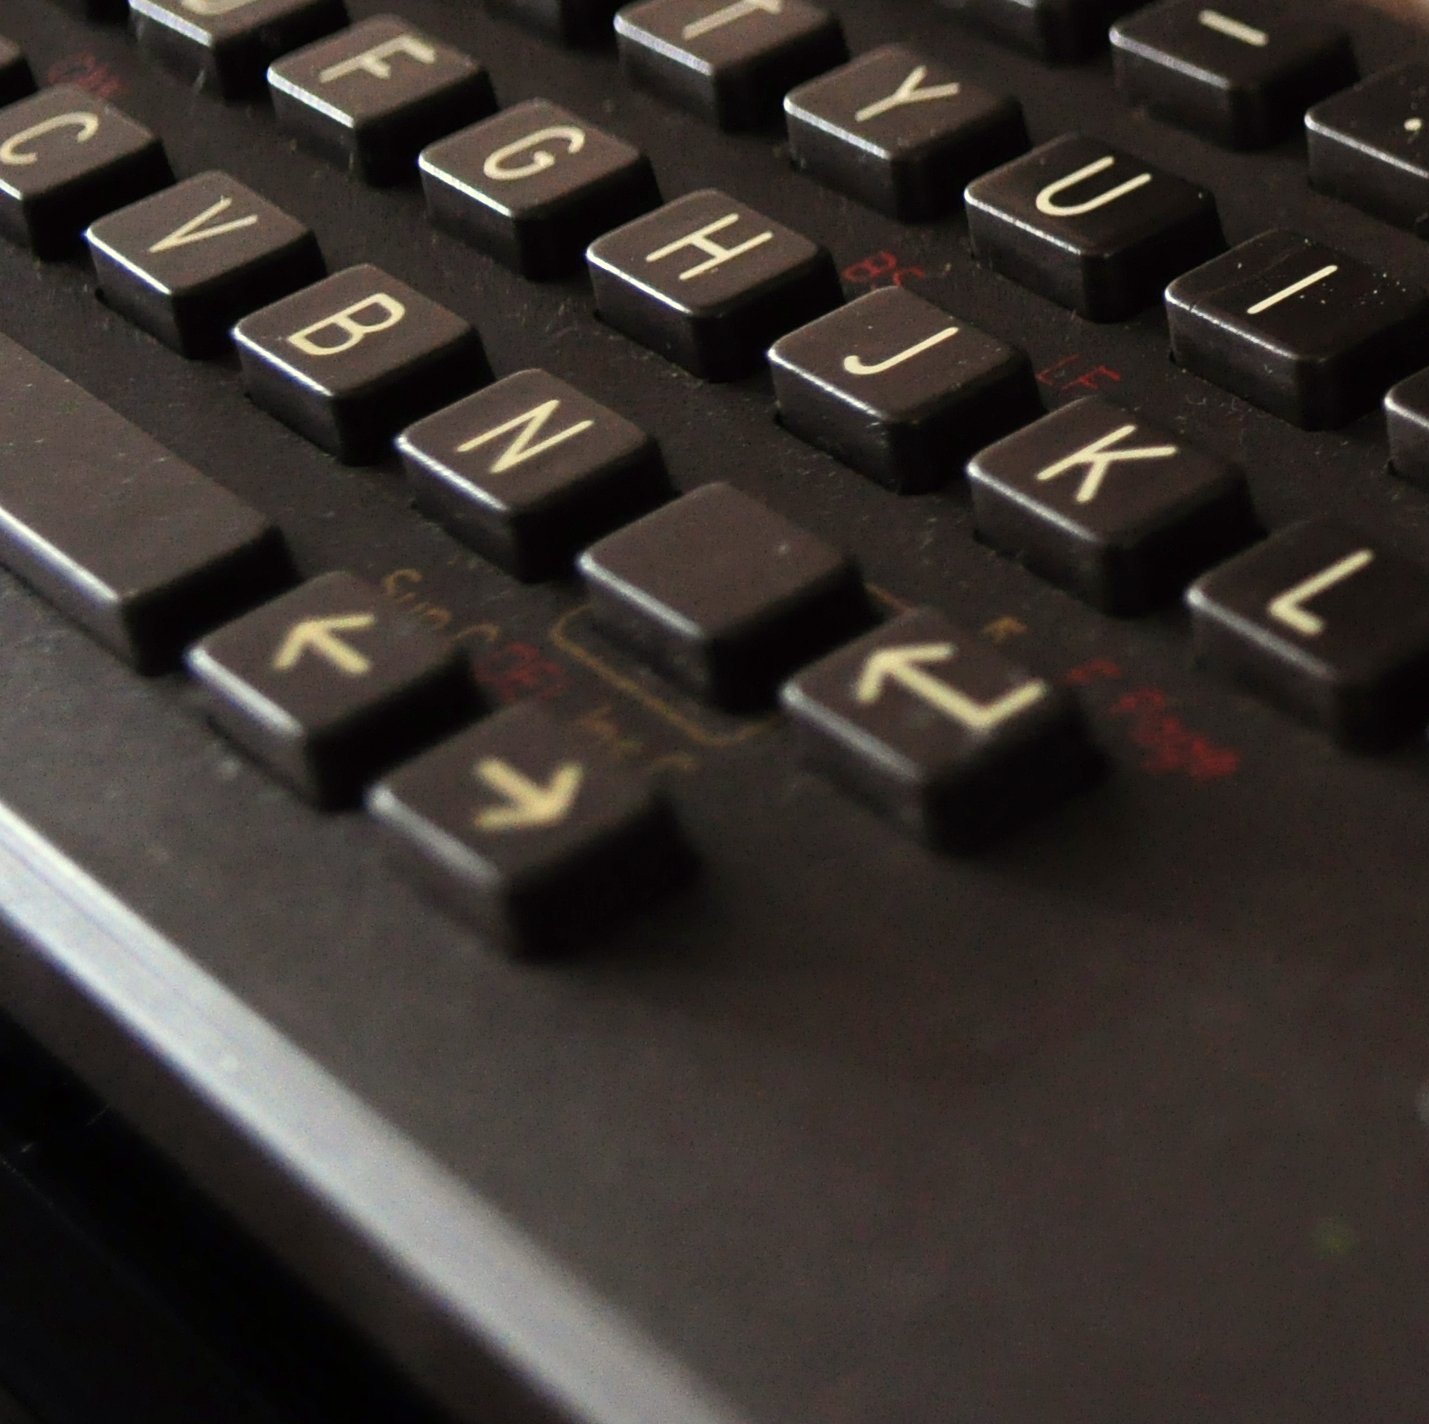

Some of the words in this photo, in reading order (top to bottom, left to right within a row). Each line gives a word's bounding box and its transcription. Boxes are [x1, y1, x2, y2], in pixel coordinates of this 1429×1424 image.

[319, 34, 437, 85] F
[855, 65, 960, 123] Y
[0, 110, 100, 167] C
[482, 125, 586, 181] G
[1035, 156, 1152, 218] U
[148, 196, 258, 254] V
[645, 212, 774, 282] H
[1247, 264, 1339, 315] I
[286, 292, 407, 357] B
[842, 326, 959, 376] J
[456, 398, 594, 475] N
[1036, 423, 1178, 504] K
[1267, 549, 1374, 637] L
